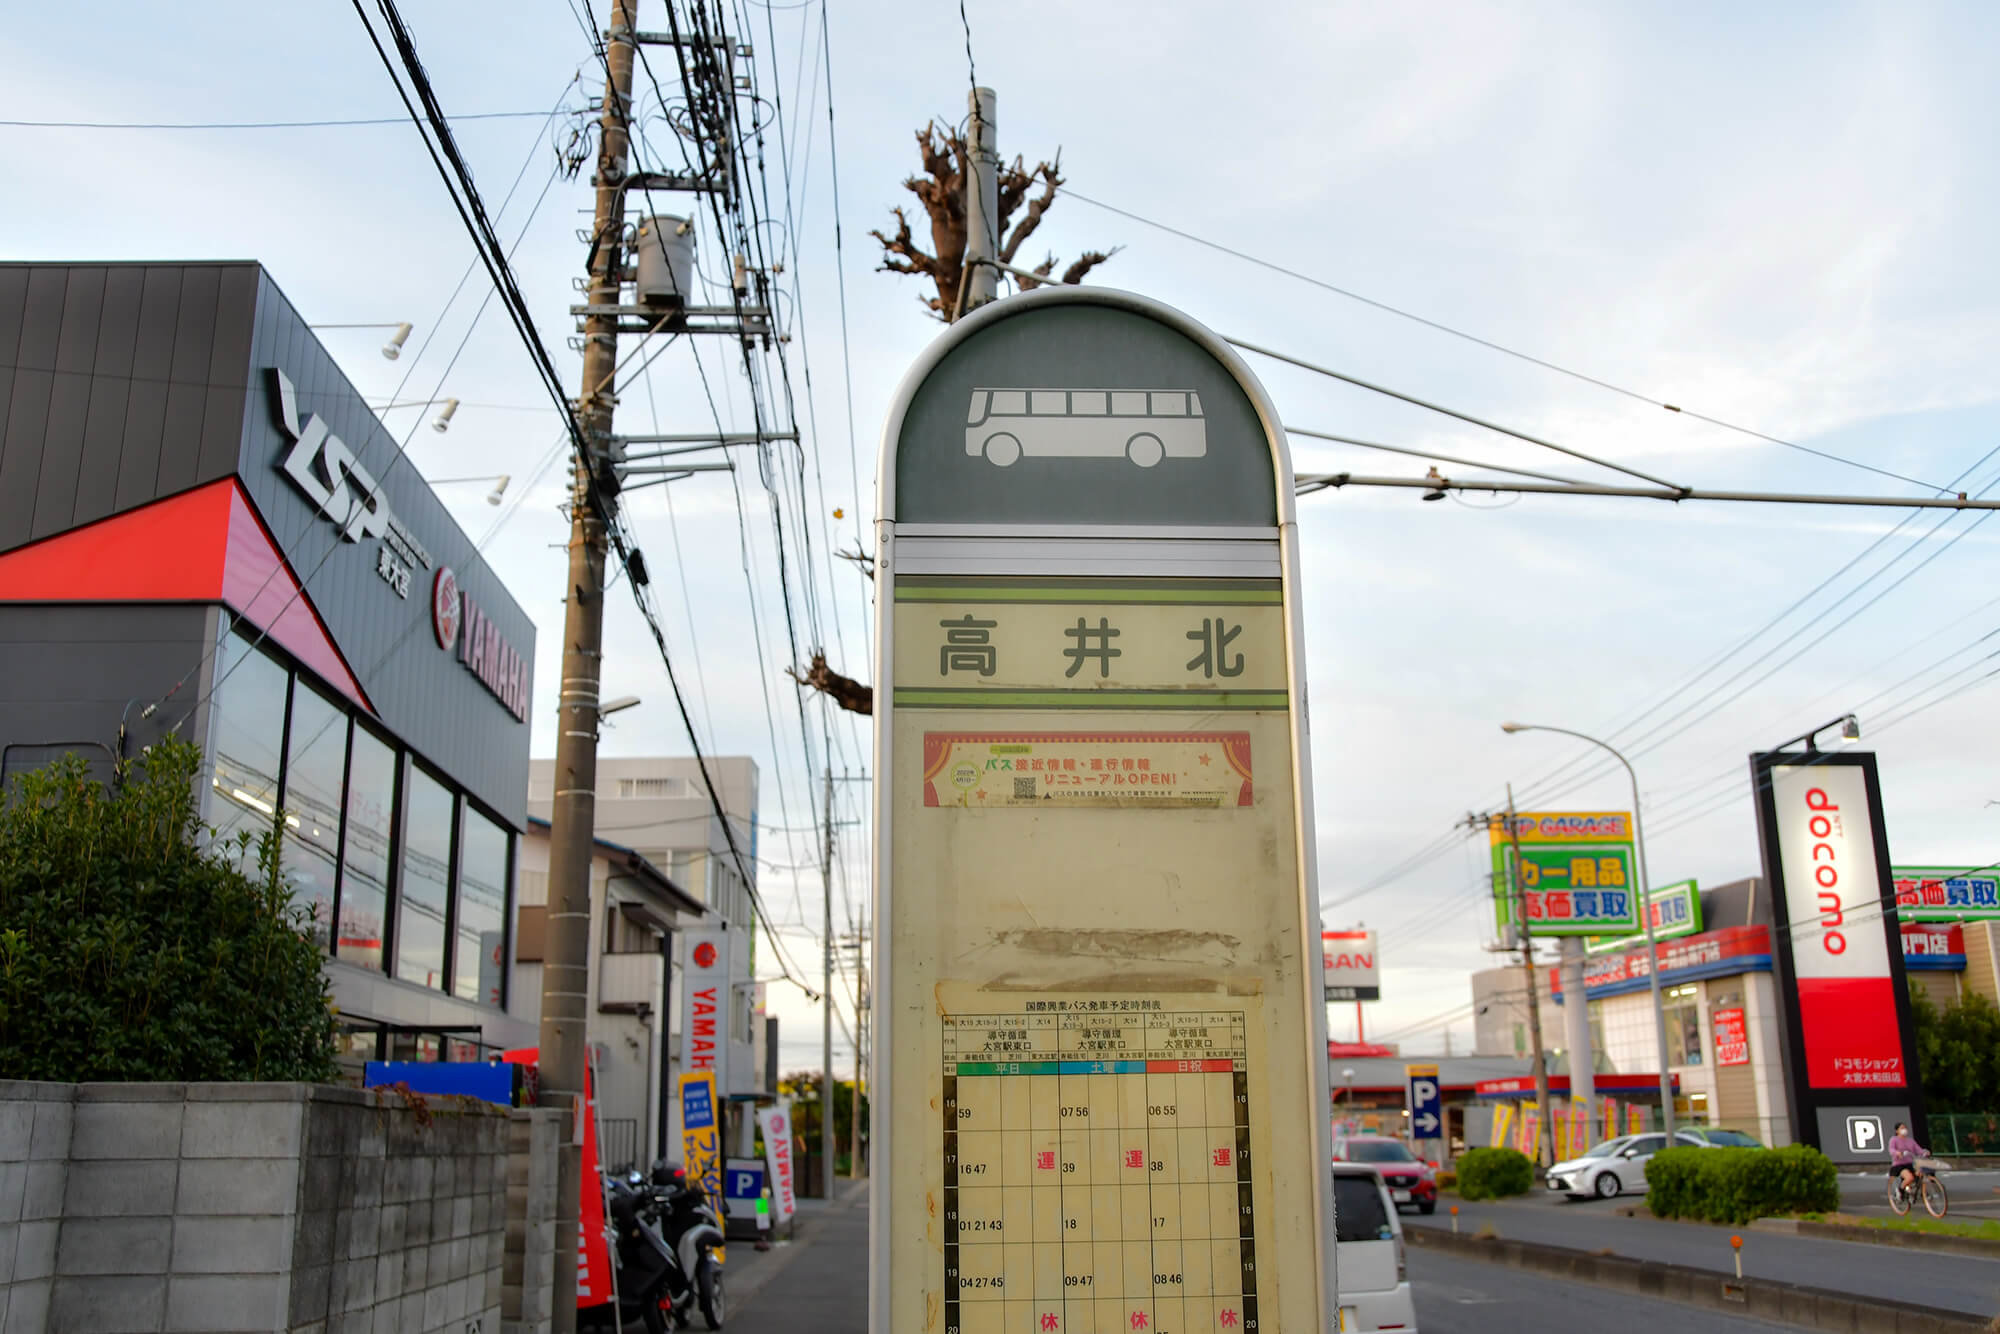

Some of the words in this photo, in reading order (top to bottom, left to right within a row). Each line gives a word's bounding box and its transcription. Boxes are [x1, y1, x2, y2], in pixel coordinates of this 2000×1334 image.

[379, 547, 411, 600] 東大宮
[939, 613, 1244, 678] 高井北
[460, 592, 526, 722] YAMAHA
[1538, 816, 1625, 836] GARAGE
[1805, 787, 1846, 956] docomo
[1894, 879, 1997, 906] 高価買取
[1517, 891, 1627, 918] 高価買取
[1026, 1000, 1161, 1012] 国際興業バス発車予定時刻表
[983, 1041, 1032, 1051] 大宮駅東口
[1078, 1040, 1126, 1050] 大宮駅東口
[1165, 1039, 1212, 1049] 大宮駅東口
[995, 1063, 1019, 1073] 平日
[1178, 1060, 1202, 1072] 日祝
[1834, 1058, 1899, 1071] ドコモショップ
[1844, 1072, 1901, 1083] 大宮大和田店
[1237, 1095, 1246, 1103] 16
[1413, 1081, 1437, 1108] P
[946, 1099, 956, 1108] 16
[958, 1108, 971, 1119] 59
[1061, 1107, 1073, 1117] 07
[1076, 1107, 1089, 1117] 56
[1148, 1105, 1161, 1116] 06
[1163, 1105, 1176, 1115] 55
[1855, 1121, 1876, 1148] P
[947, 1155, 956, 1164] 17
[1125, 1149, 1144, 1168] 運
[1213, 1148, 1231, 1166] 運
[1239, 1150, 1248, 1159] 17
[1037, 1151, 1055, 1170] 運
[960, 1164, 972, 1174] 16
[974, 1164, 987, 1174] 47
[1062, 1162, 1075, 1173] 39
[1150, 1161, 1163, 1172] 38
[736, 1173, 753, 1196] P
[947, 1211, 957, 1220] 18
[1241, 1206, 1252, 1215] 18
[960, 1220, 971, 1230] 01
[975, 1220, 986, 1230] 21
[990, 1220, 1002, 1230] 43
[1065, 1219, 1077, 1229] 18
[1153, 1217, 1165, 1228] 17
[947, 1268, 958, 1277] 19
[1244, 1263, 1254, 1271] 19
[960, 1278, 973, 1288] 04
[975, 1278, 988, 1288] 27
[990, 1277, 1003, 1287] 45
[1064, 1276, 1078, 1286] 09
[1080, 1276, 1093, 1286] 47
[1154, 1274, 1167, 1284] 08
[1169, 1274, 1182, 1284] 46
[1040, 1313, 1058, 1332] 休
[1130, 1311, 1149, 1330] 休
[1220, 1309, 1238, 1328] 休
[947, 1326, 959, 1334] 20
[1246, 1320, 1257, 1329] 20
